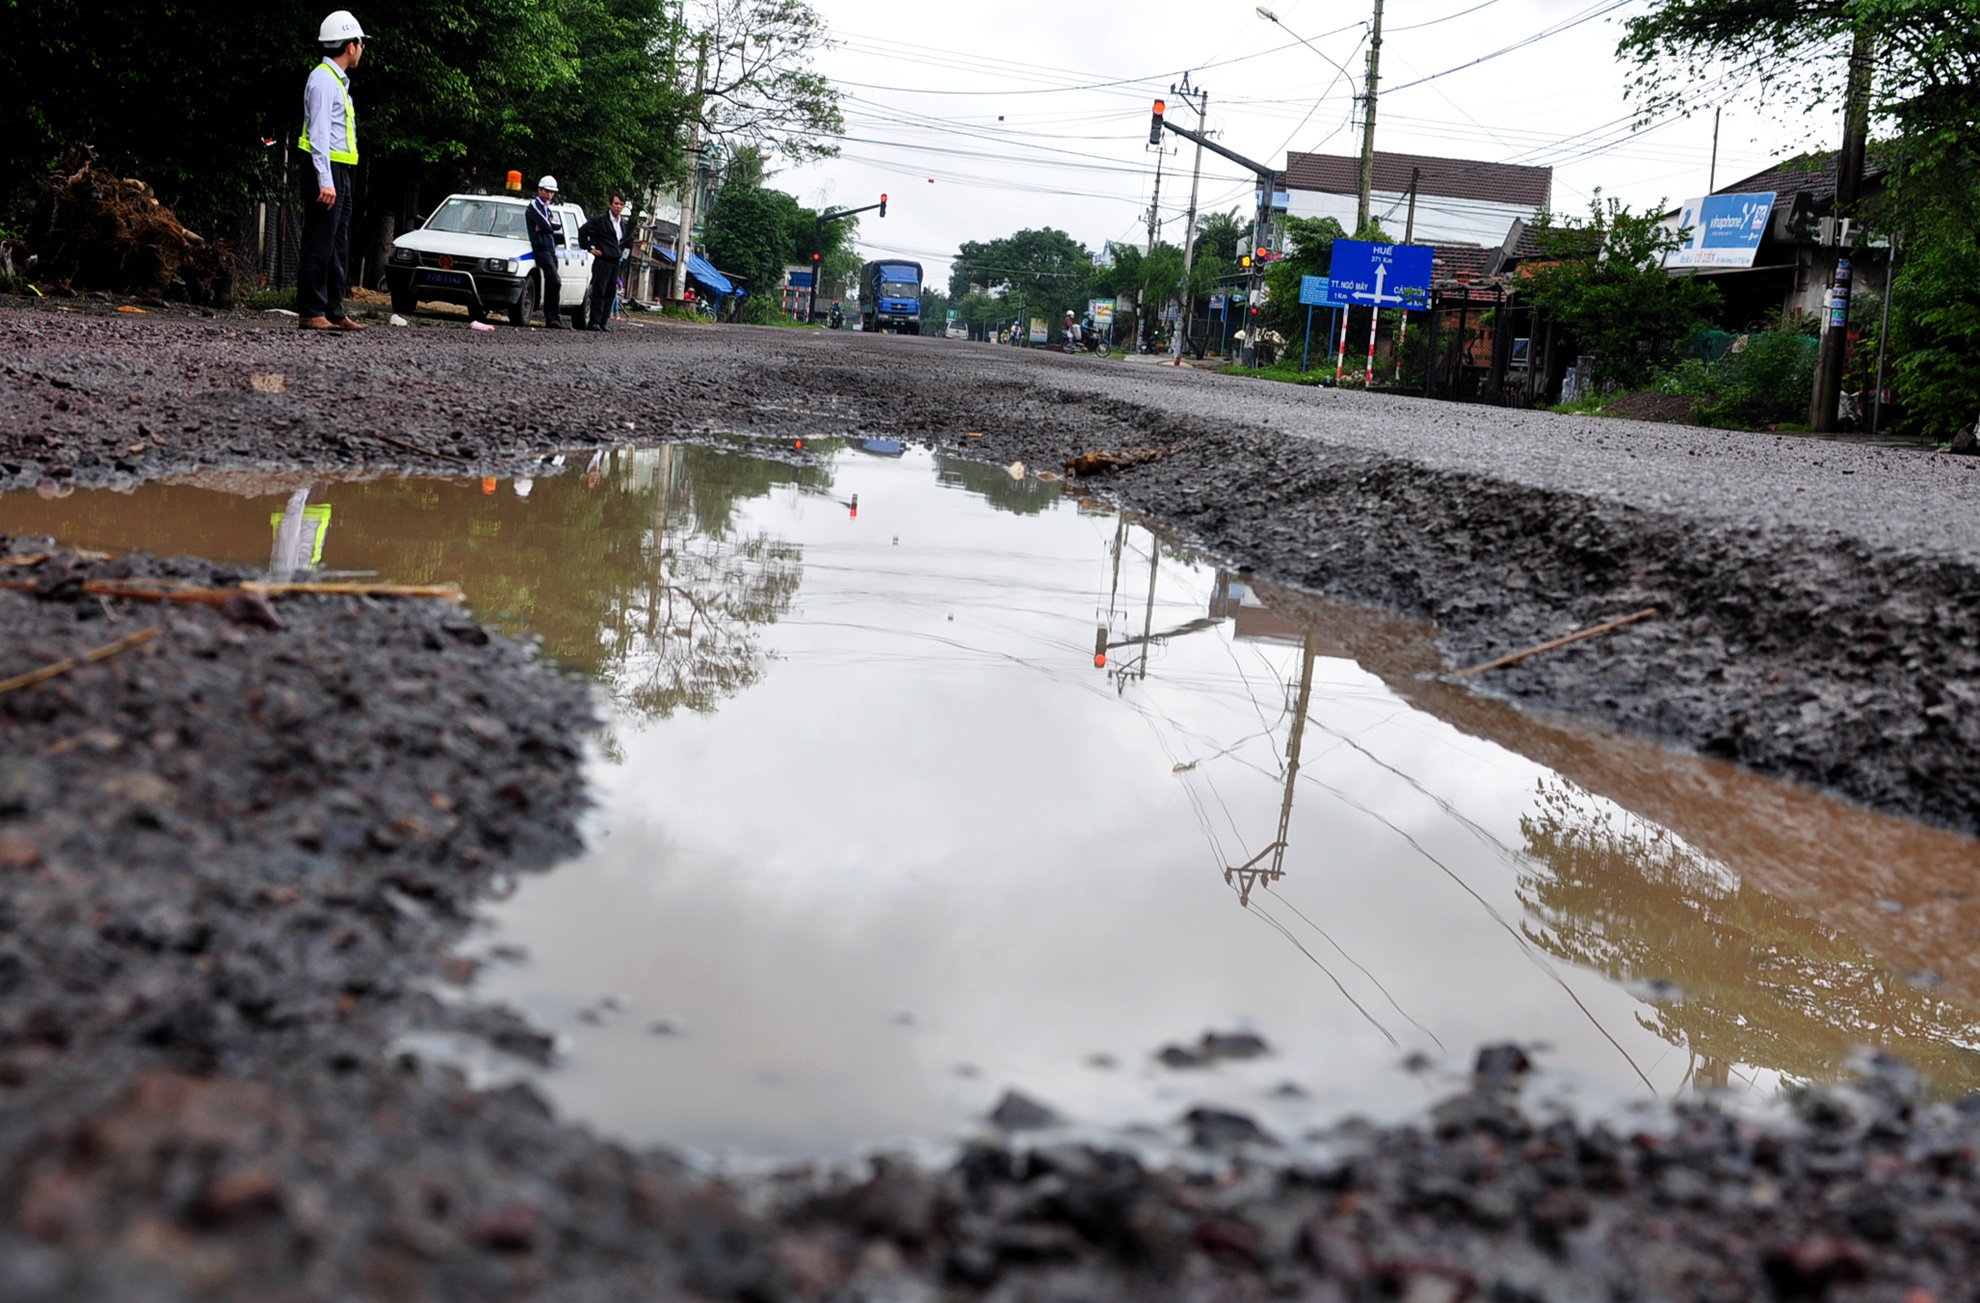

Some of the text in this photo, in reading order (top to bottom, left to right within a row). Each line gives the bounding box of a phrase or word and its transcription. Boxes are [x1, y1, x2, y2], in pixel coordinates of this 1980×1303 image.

[1710, 214, 1743, 230] vinaphone
[1373, 245, 1394, 255] HUẾ
[1371, 255, 1393, 264] 371 Km
[1393, 285, 1406, 295] CÁ
[1337, 292, 1348, 300] Km
